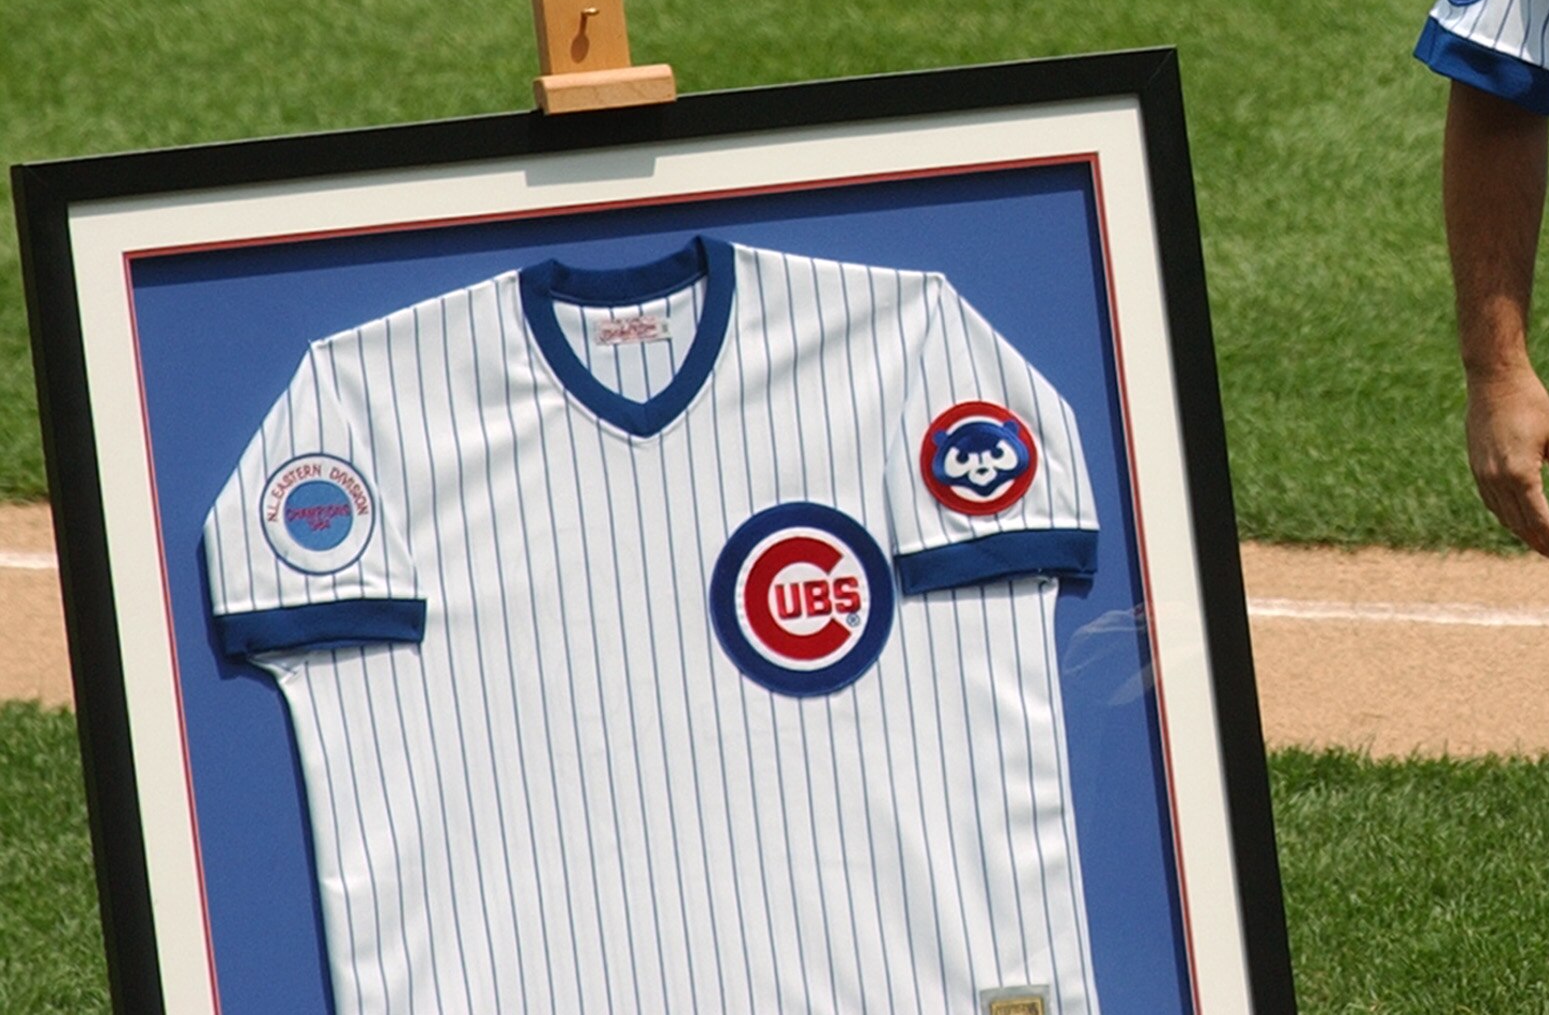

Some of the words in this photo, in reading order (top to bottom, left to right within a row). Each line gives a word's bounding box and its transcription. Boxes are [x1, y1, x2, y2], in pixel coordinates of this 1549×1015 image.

[271, 464, 322, 500] EASTERN
[329, 466, 369, 516] DIVISION
[744, 536, 862, 662] CUBS
